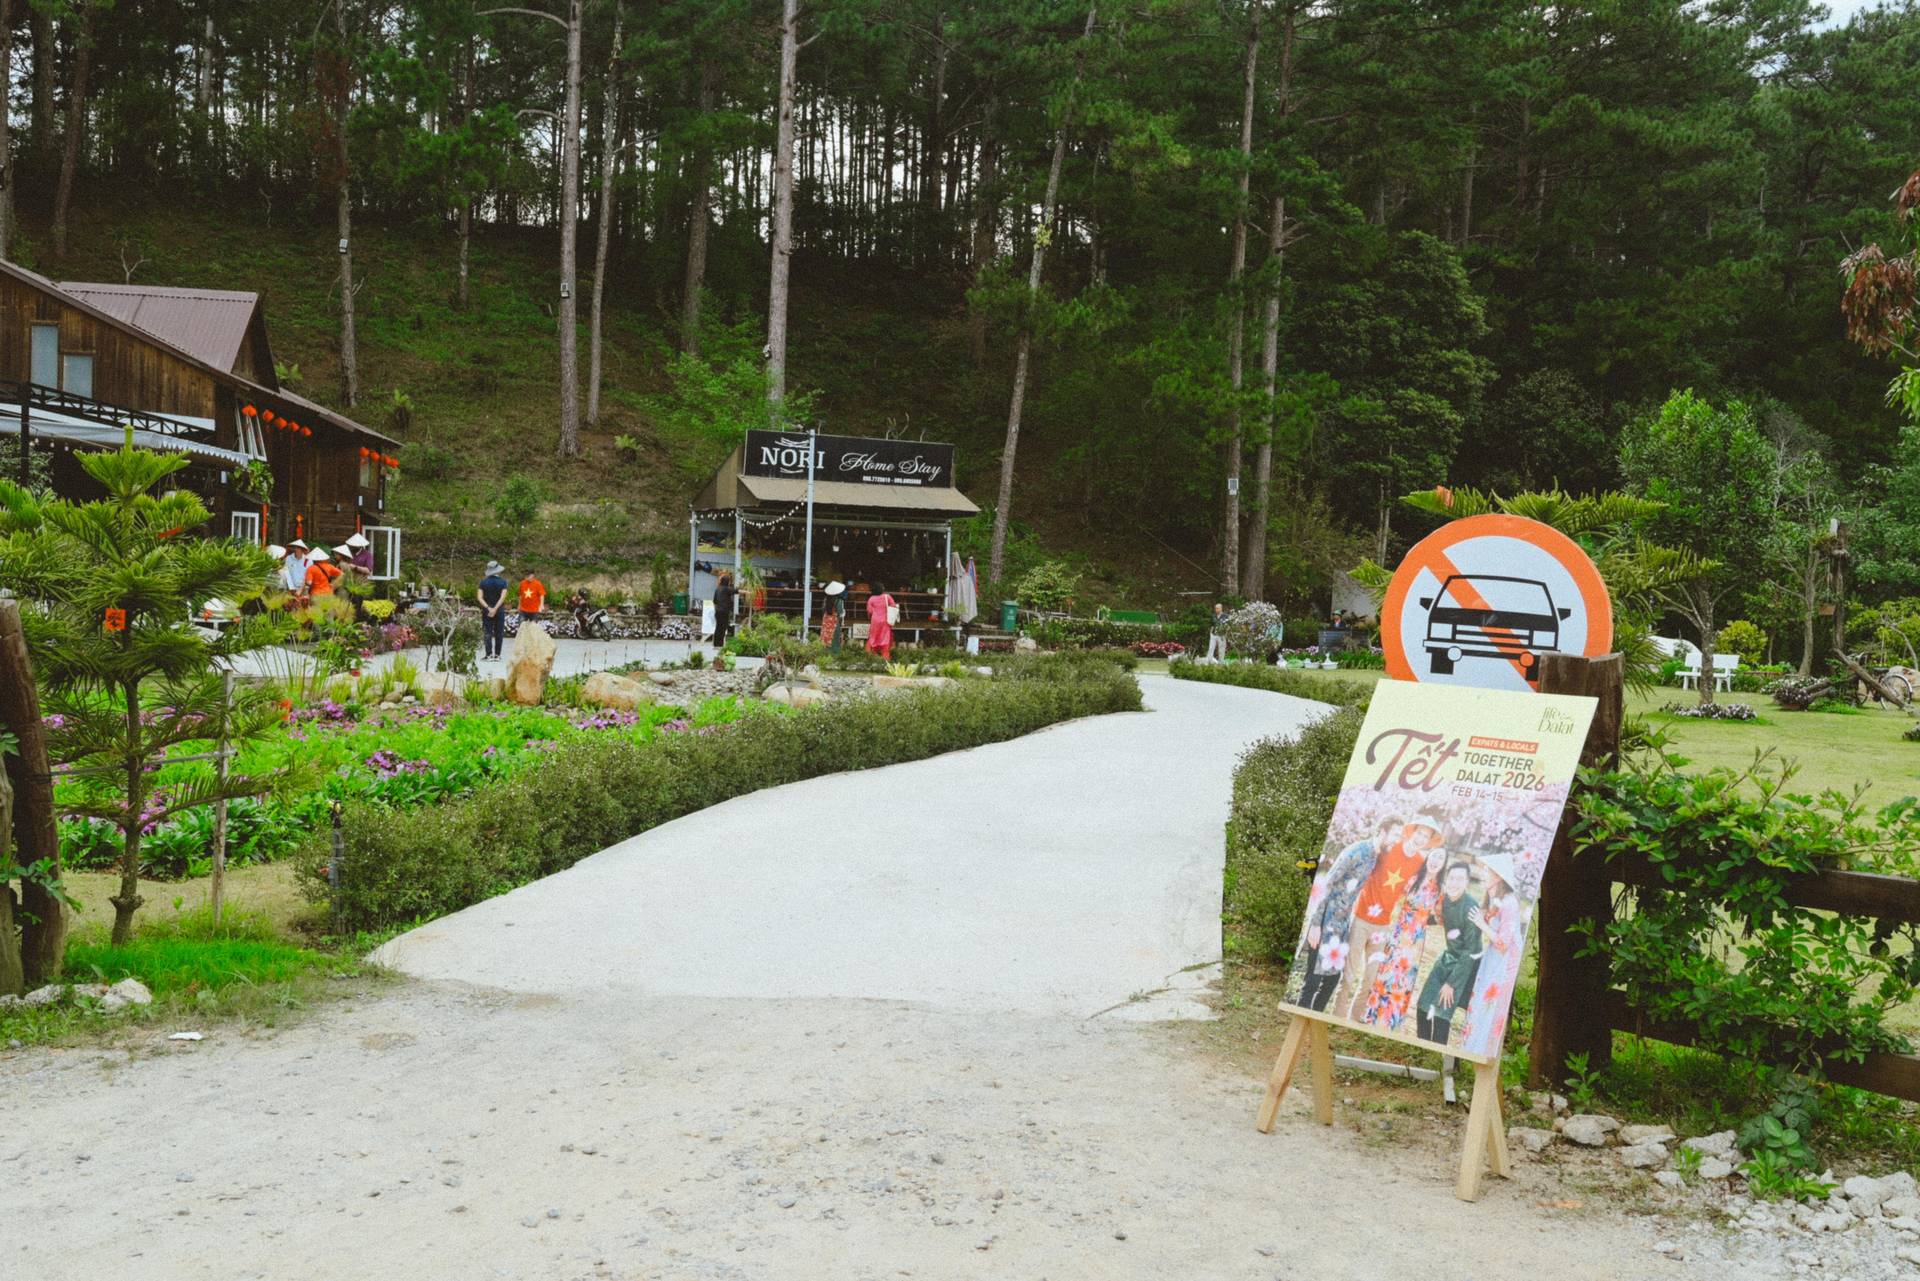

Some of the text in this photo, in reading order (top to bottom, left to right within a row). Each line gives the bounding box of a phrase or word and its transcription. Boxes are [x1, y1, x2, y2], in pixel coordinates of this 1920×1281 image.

[760, 446, 825, 469] NORI
[838, 452, 895, 471] Home
[898, 455, 942, 482] Stay
[1538, 719, 1575, 735] Dalat
[1471, 737, 1498, 749] EXPATS
[1506, 742, 1536, 753] LOCALS
[1366, 728, 1461, 792] Tết
[1464, 752, 1534, 771] TOGETHER
[1456, 769, 1545, 791] DALAT 2026
[1452, 786, 1473, 798] FEB
